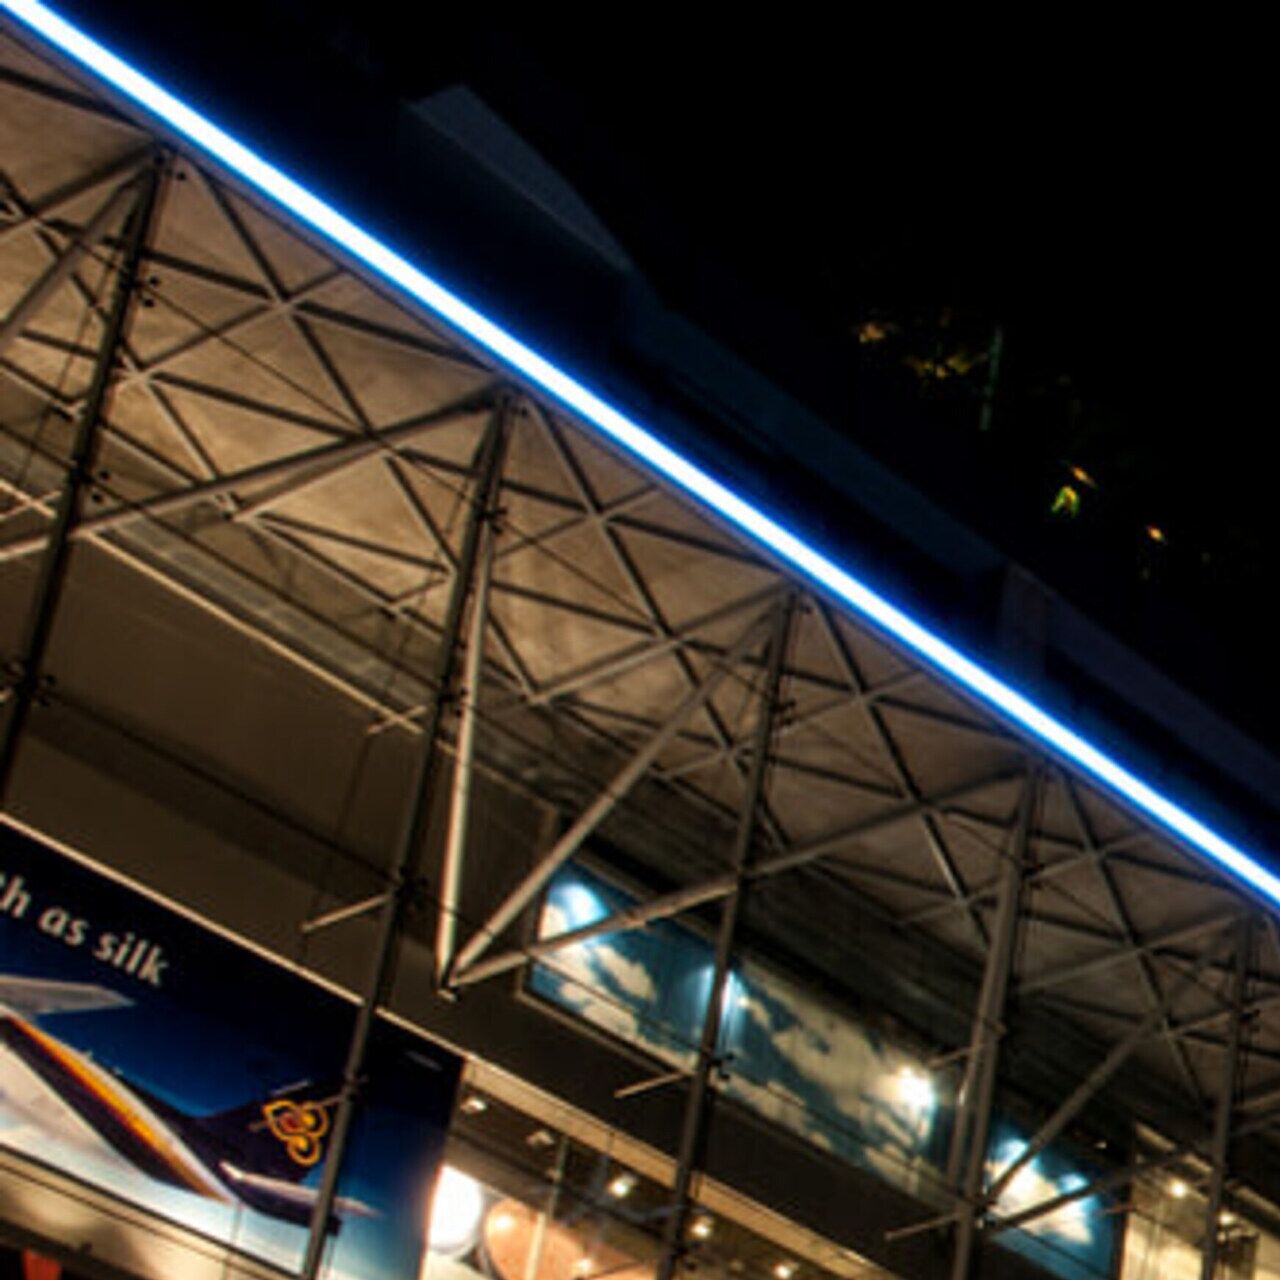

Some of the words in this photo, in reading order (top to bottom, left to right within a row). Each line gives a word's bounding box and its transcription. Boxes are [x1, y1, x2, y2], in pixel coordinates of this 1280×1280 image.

[0, 872, 31, 918] h
[37, 906, 90, 947] as
[92, 932, 170, 986] silk
